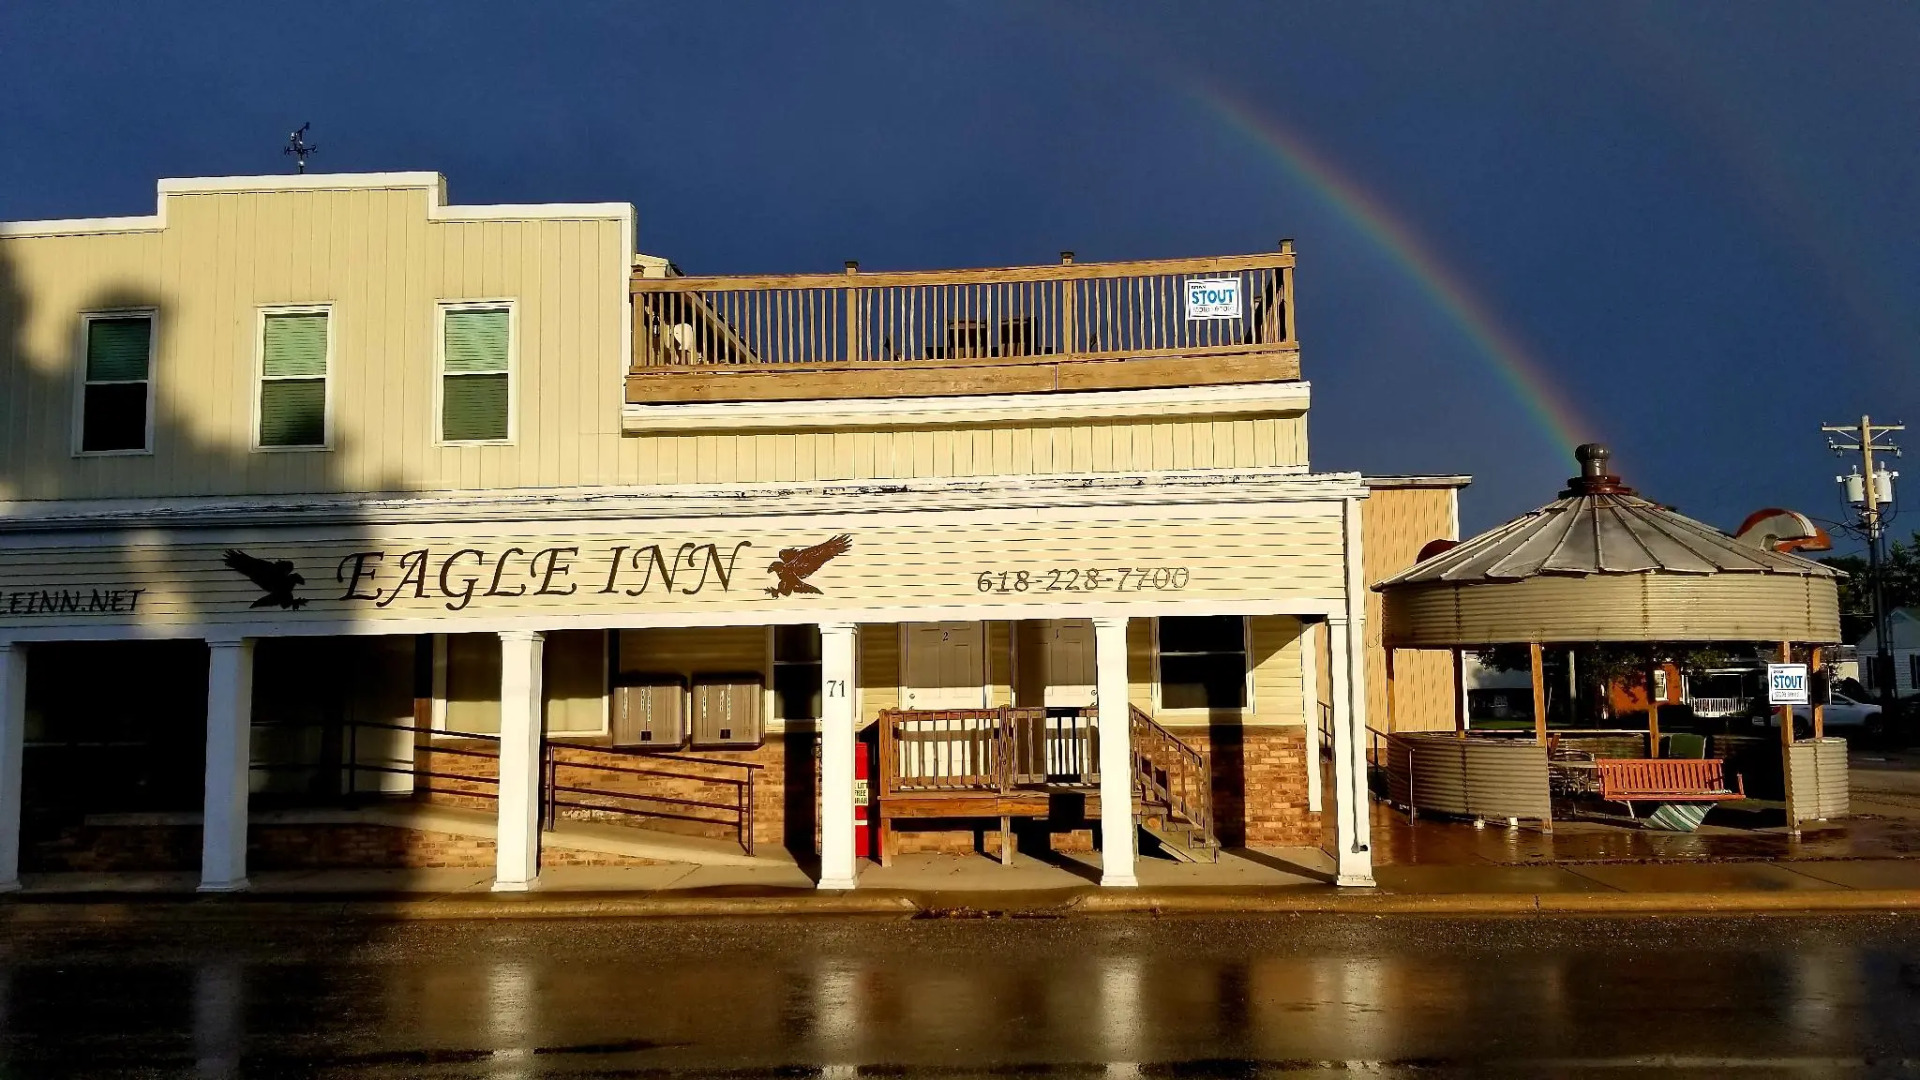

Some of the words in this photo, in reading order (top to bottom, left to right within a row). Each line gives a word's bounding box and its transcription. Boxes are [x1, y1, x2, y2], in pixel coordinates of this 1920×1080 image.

[1192, 289, 1234, 304] STOUT
[336, 546, 579, 610] EAGLE
[597, 540, 752, 597] INN
[977, 566, 1190, 592] 618-228-7700
[942, 631, 949, 642] 2
[826, 680, 846, 697] 71
[1773, 675, 1803, 689] STOUT
